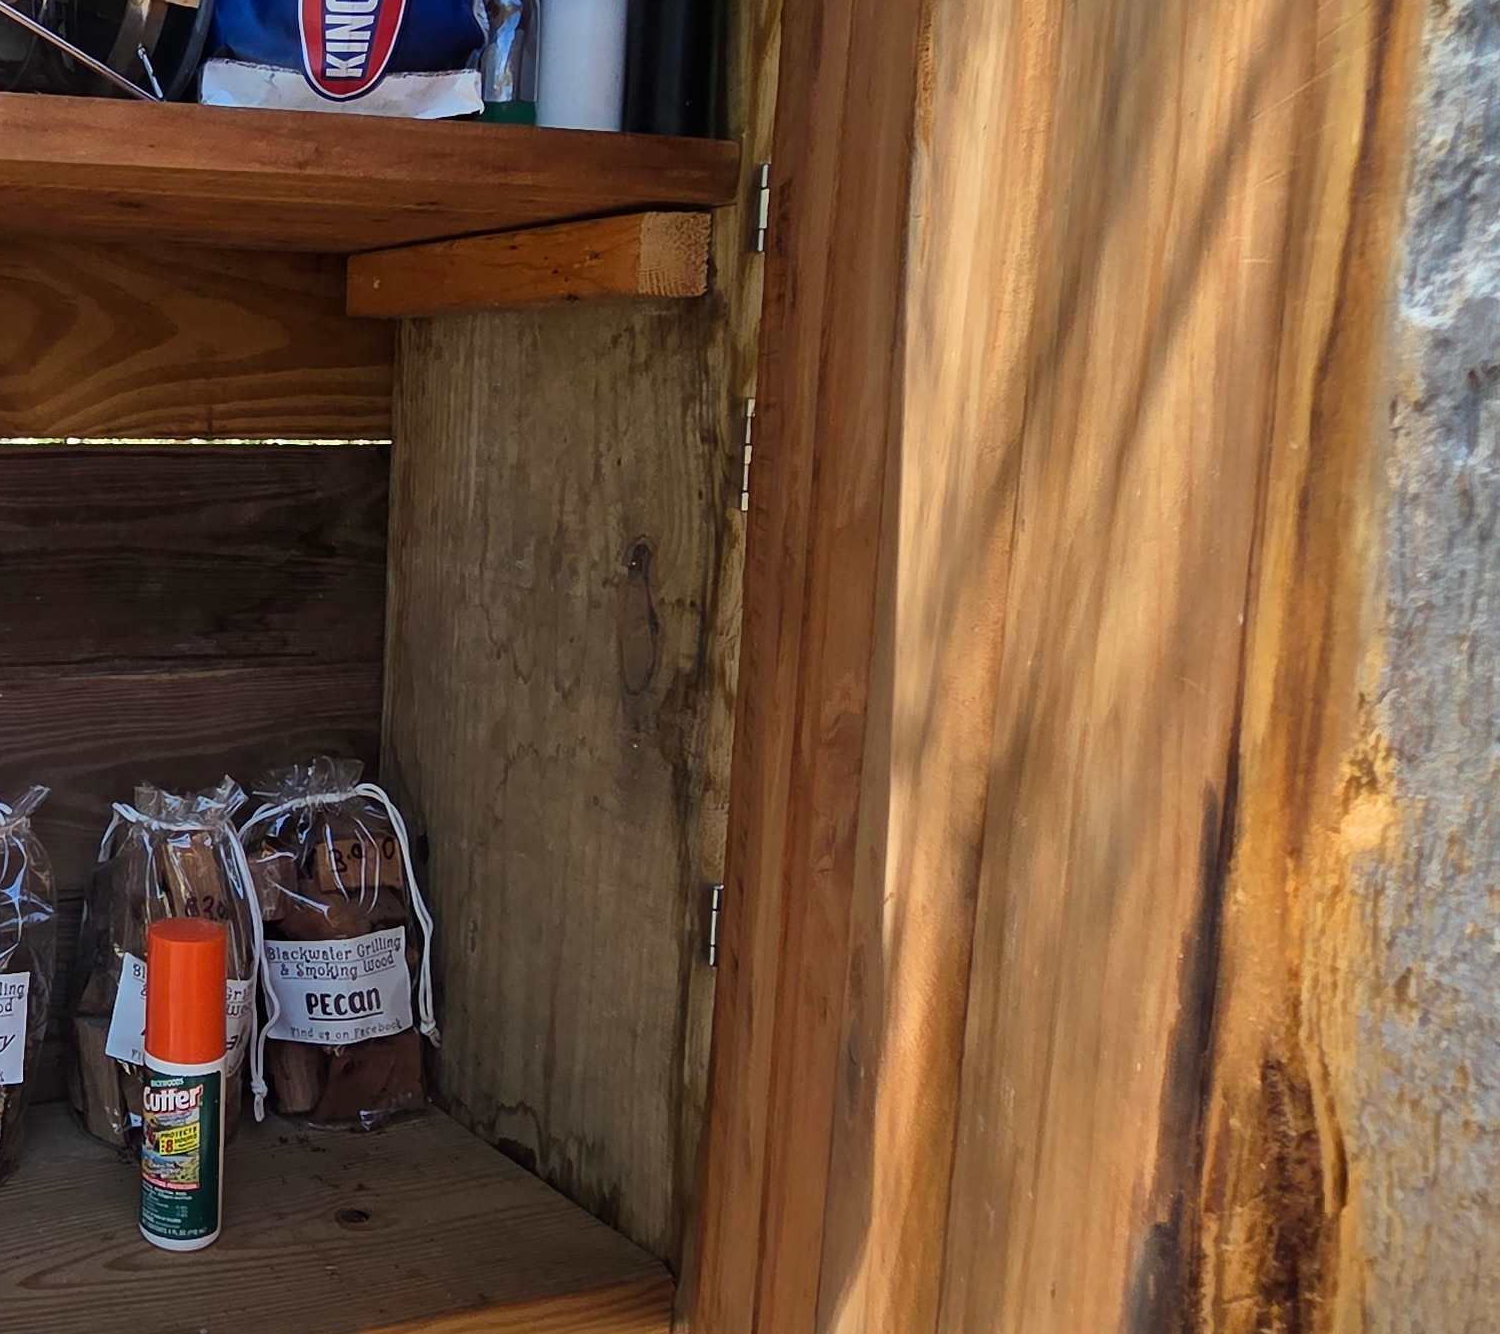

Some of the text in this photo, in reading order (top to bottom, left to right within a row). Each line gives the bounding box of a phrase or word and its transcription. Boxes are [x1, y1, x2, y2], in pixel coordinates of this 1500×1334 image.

[266, 935, 402, 963] Blackwater Grilling
[280, 950, 395, 981] & Smoking Wood
[290, 1026, 314, 1039] Find
[335, 1029, 350, 1039] on
[354, 1018, 403, 1039] Facebook
[143, 1084, 203, 1112] Cutter
[165, 1139, 174, 1154] 8
